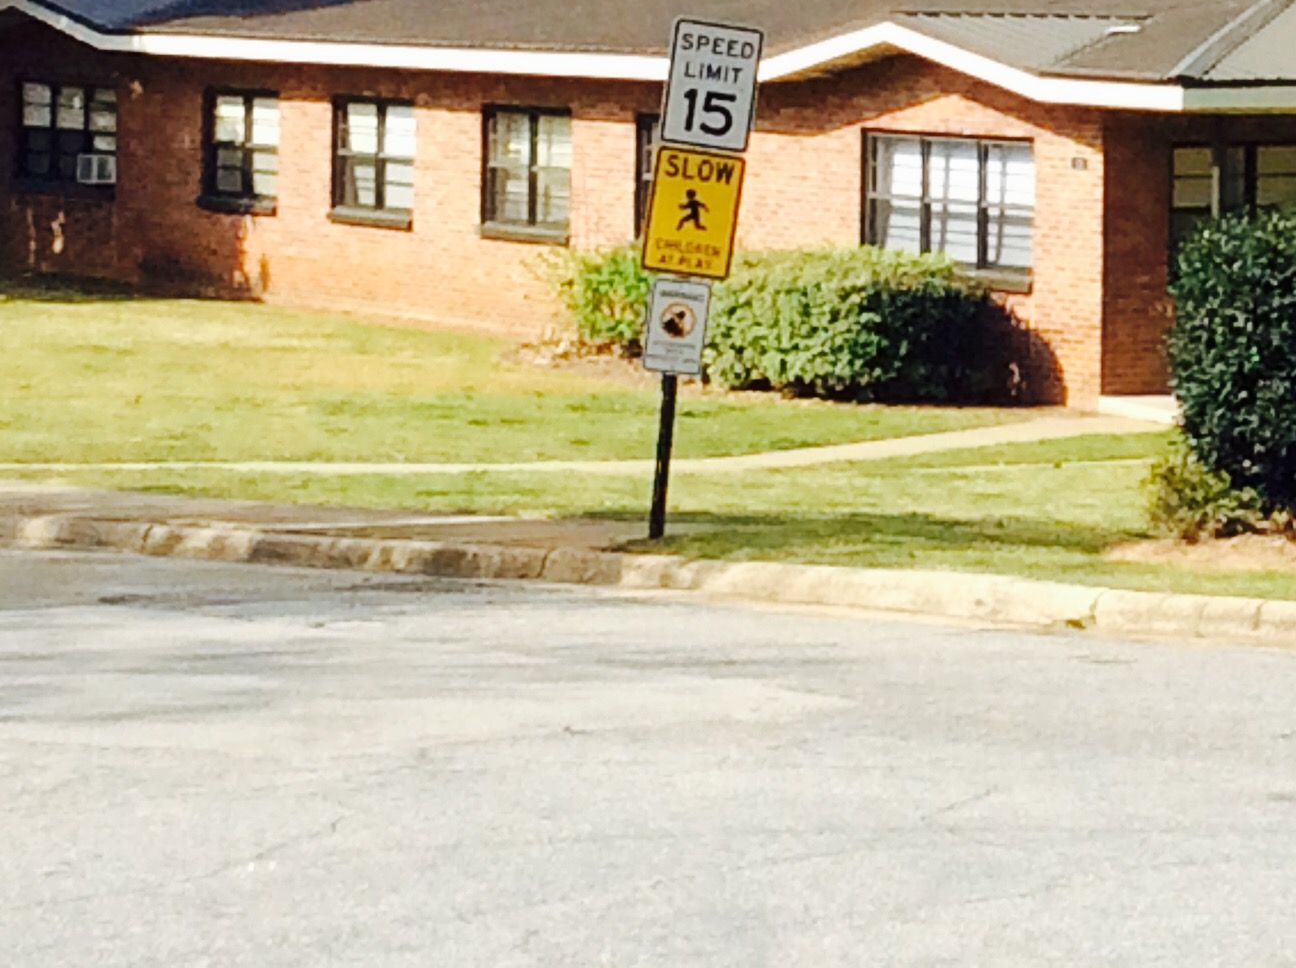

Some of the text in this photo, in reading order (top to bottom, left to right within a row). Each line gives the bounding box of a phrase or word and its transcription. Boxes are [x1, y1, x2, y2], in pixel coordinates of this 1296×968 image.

[680, 33, 755, 59] SPEED
[684, 61, 743, 83] LIMIT
[683, 88, 737, 137] 15
[665, 154, 735, 185] SLOW
